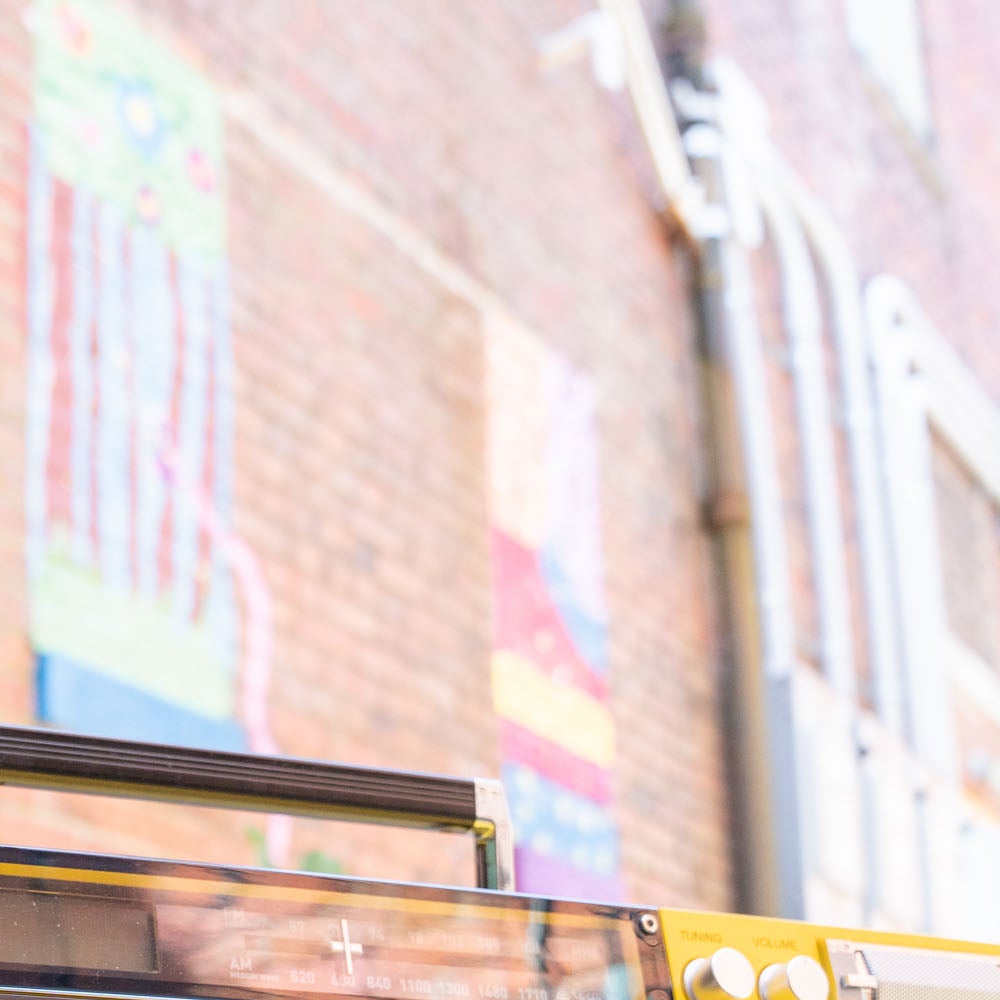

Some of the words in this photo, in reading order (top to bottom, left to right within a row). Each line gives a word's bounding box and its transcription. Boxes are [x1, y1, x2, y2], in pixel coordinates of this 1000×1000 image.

[680, 930, 723, 945] TUNING
[752, 936, 798, 951] VOLUME
[230, 956, 253, 972] AM
[289, 969, 315, 985] 520
[366, 975, 393, 991] 840
[400, 978, 433, 994] 1100
